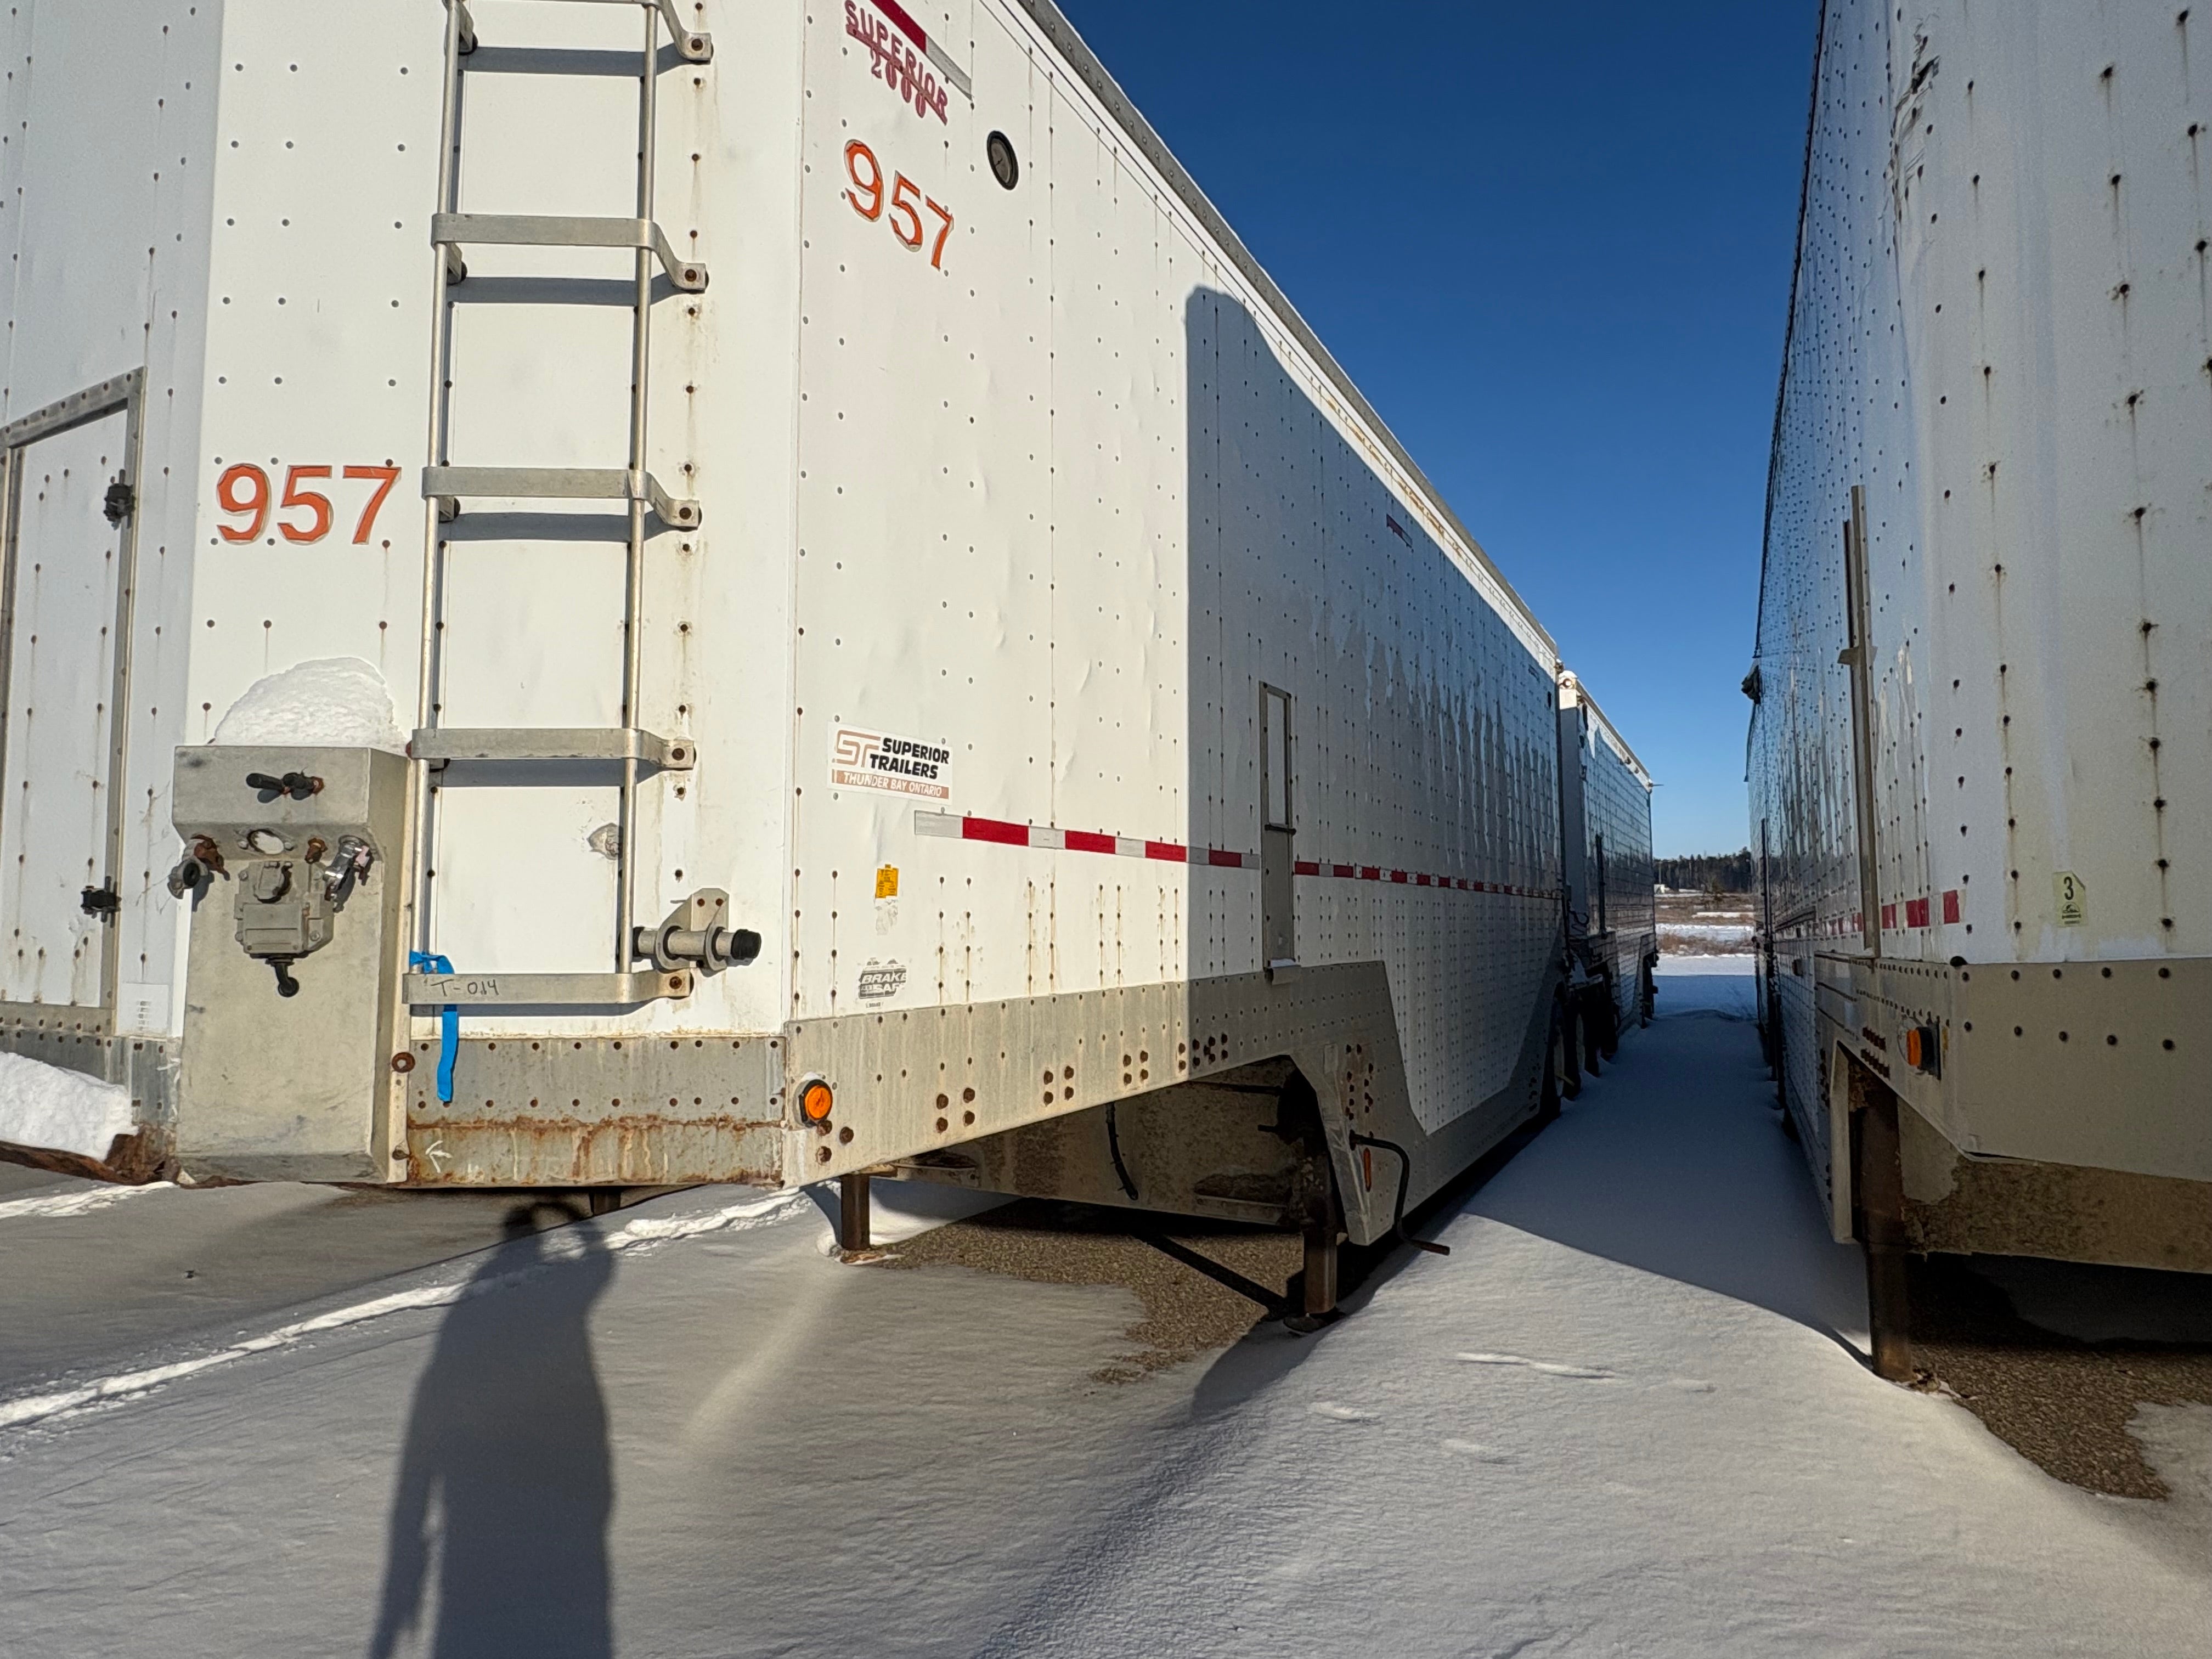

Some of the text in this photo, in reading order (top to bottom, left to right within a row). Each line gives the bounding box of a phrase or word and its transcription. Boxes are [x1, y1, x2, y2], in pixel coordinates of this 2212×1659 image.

[844, 0, 948, 126] SUPERIOR
[870, 47, 926, 119] 2000
[844, 139, 955, 271] 957
[216, 463, 402, 545] 957
[882, 737, 950, 764] SUPERIOR
[870, 753, 939, 780] TRAILERS
[844, 771, 942, 797] THUNDER BAY ONTARIO
[2064, 876, 2074, 900] 3
[861, 970, 906, 984] BRAKE
